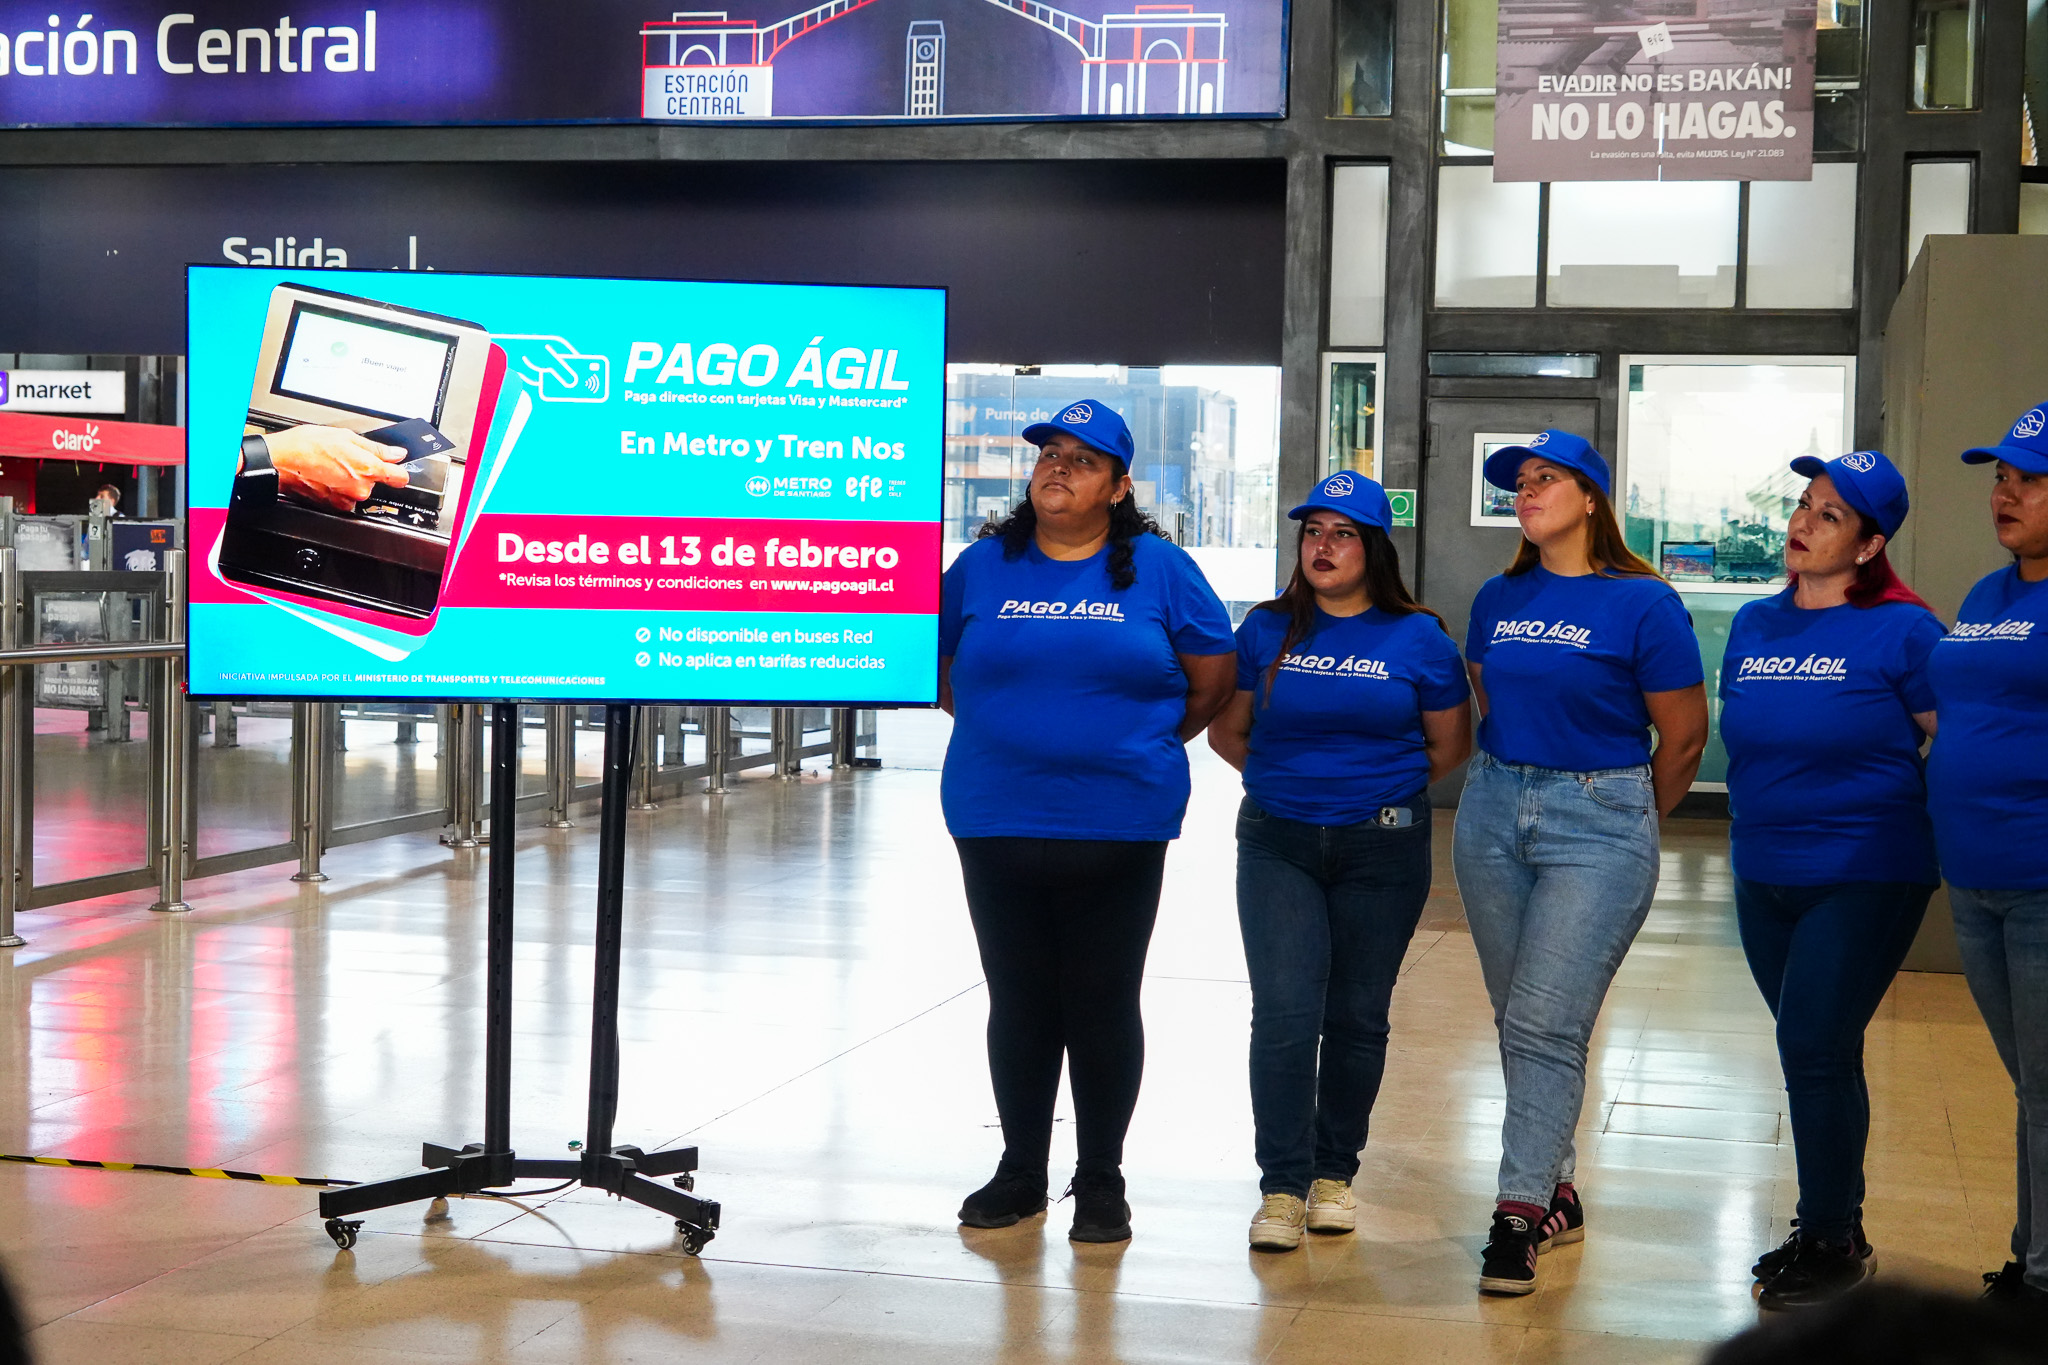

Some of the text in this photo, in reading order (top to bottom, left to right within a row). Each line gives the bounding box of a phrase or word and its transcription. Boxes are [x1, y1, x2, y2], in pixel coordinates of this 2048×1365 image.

[0, 10, 376, 76] ción Central
[665, 69, 748, 93] ESTACIÓN
[1538, 62, 1791, 95] EVADIR NO ES BAKÁN!
[667, 97, 745, 115] CENTRAL
[1532, 100, 1797, 140] NO LO HAGAS.
[1601, 150, 1630, 159] evasión
[1676, 150, 1695, 159] evita
[1731, 150, 1745, 160] Ley
[222, 236, 348, 268] Salida
[624, 336, 910, 391] PAGO ÁGIL
[16, 381, 92, 400] market
[624, 390, 657, 405] Paga
[659, 391, 707, 404] directo
[709, 394, 734, 404] con
[736, 394, 786, 407] tarjetas
[789, 395, 816, 406] Visa
[818, 397, 826, 409] y
[985, 408, 1026, 421] Punto
[1030, 408, 1049, 420] de
[52, 430, 93, 451] Claro
[620, 431, 905, 463] En Metro y Tren Nos
[773, 477, 832, 490] METRO
[845, 475, 882, 502] efe
[498, 533, 899, 569] Desde el 13 de febrero
[554, 574, 575, 588] los
[578, 574, 642, 589] términos
[645, 578, 654, 591] y
[656, 575, 743, 590] condiciones
[750, 579, 768, 590] en
[771, 577, 894, 594] www.pagoagil.cl
[1000, 599, 1124, 617] PAGO ÁGIL
[659, 628, 873, 645] No disponible en buses Red
[1493, 620, 1591, 644] PAGO ÁGIL
[1984, 619, 2035, 636] ÁGIL
[659, 653, 886, 669] No aplica en tarifas reducidas
[1336, 655, 1389, 676] ÁGIL
[1739, 653, 1847, 675] PAGO ÁGIL
[219, 673, 266, 681] INICIATIVA
[268, 673, 319, 681] IMPULSADA
[355, 674, 408, 683] MINISTERIO
[411, 675, 423, 683] DE
[425, 675, 490, 684] TRANSPORTES
[500, 676, 606, 685] TELECOMUNICACIONES
[43, 684, 100, 697] NO LO HAGAS.
